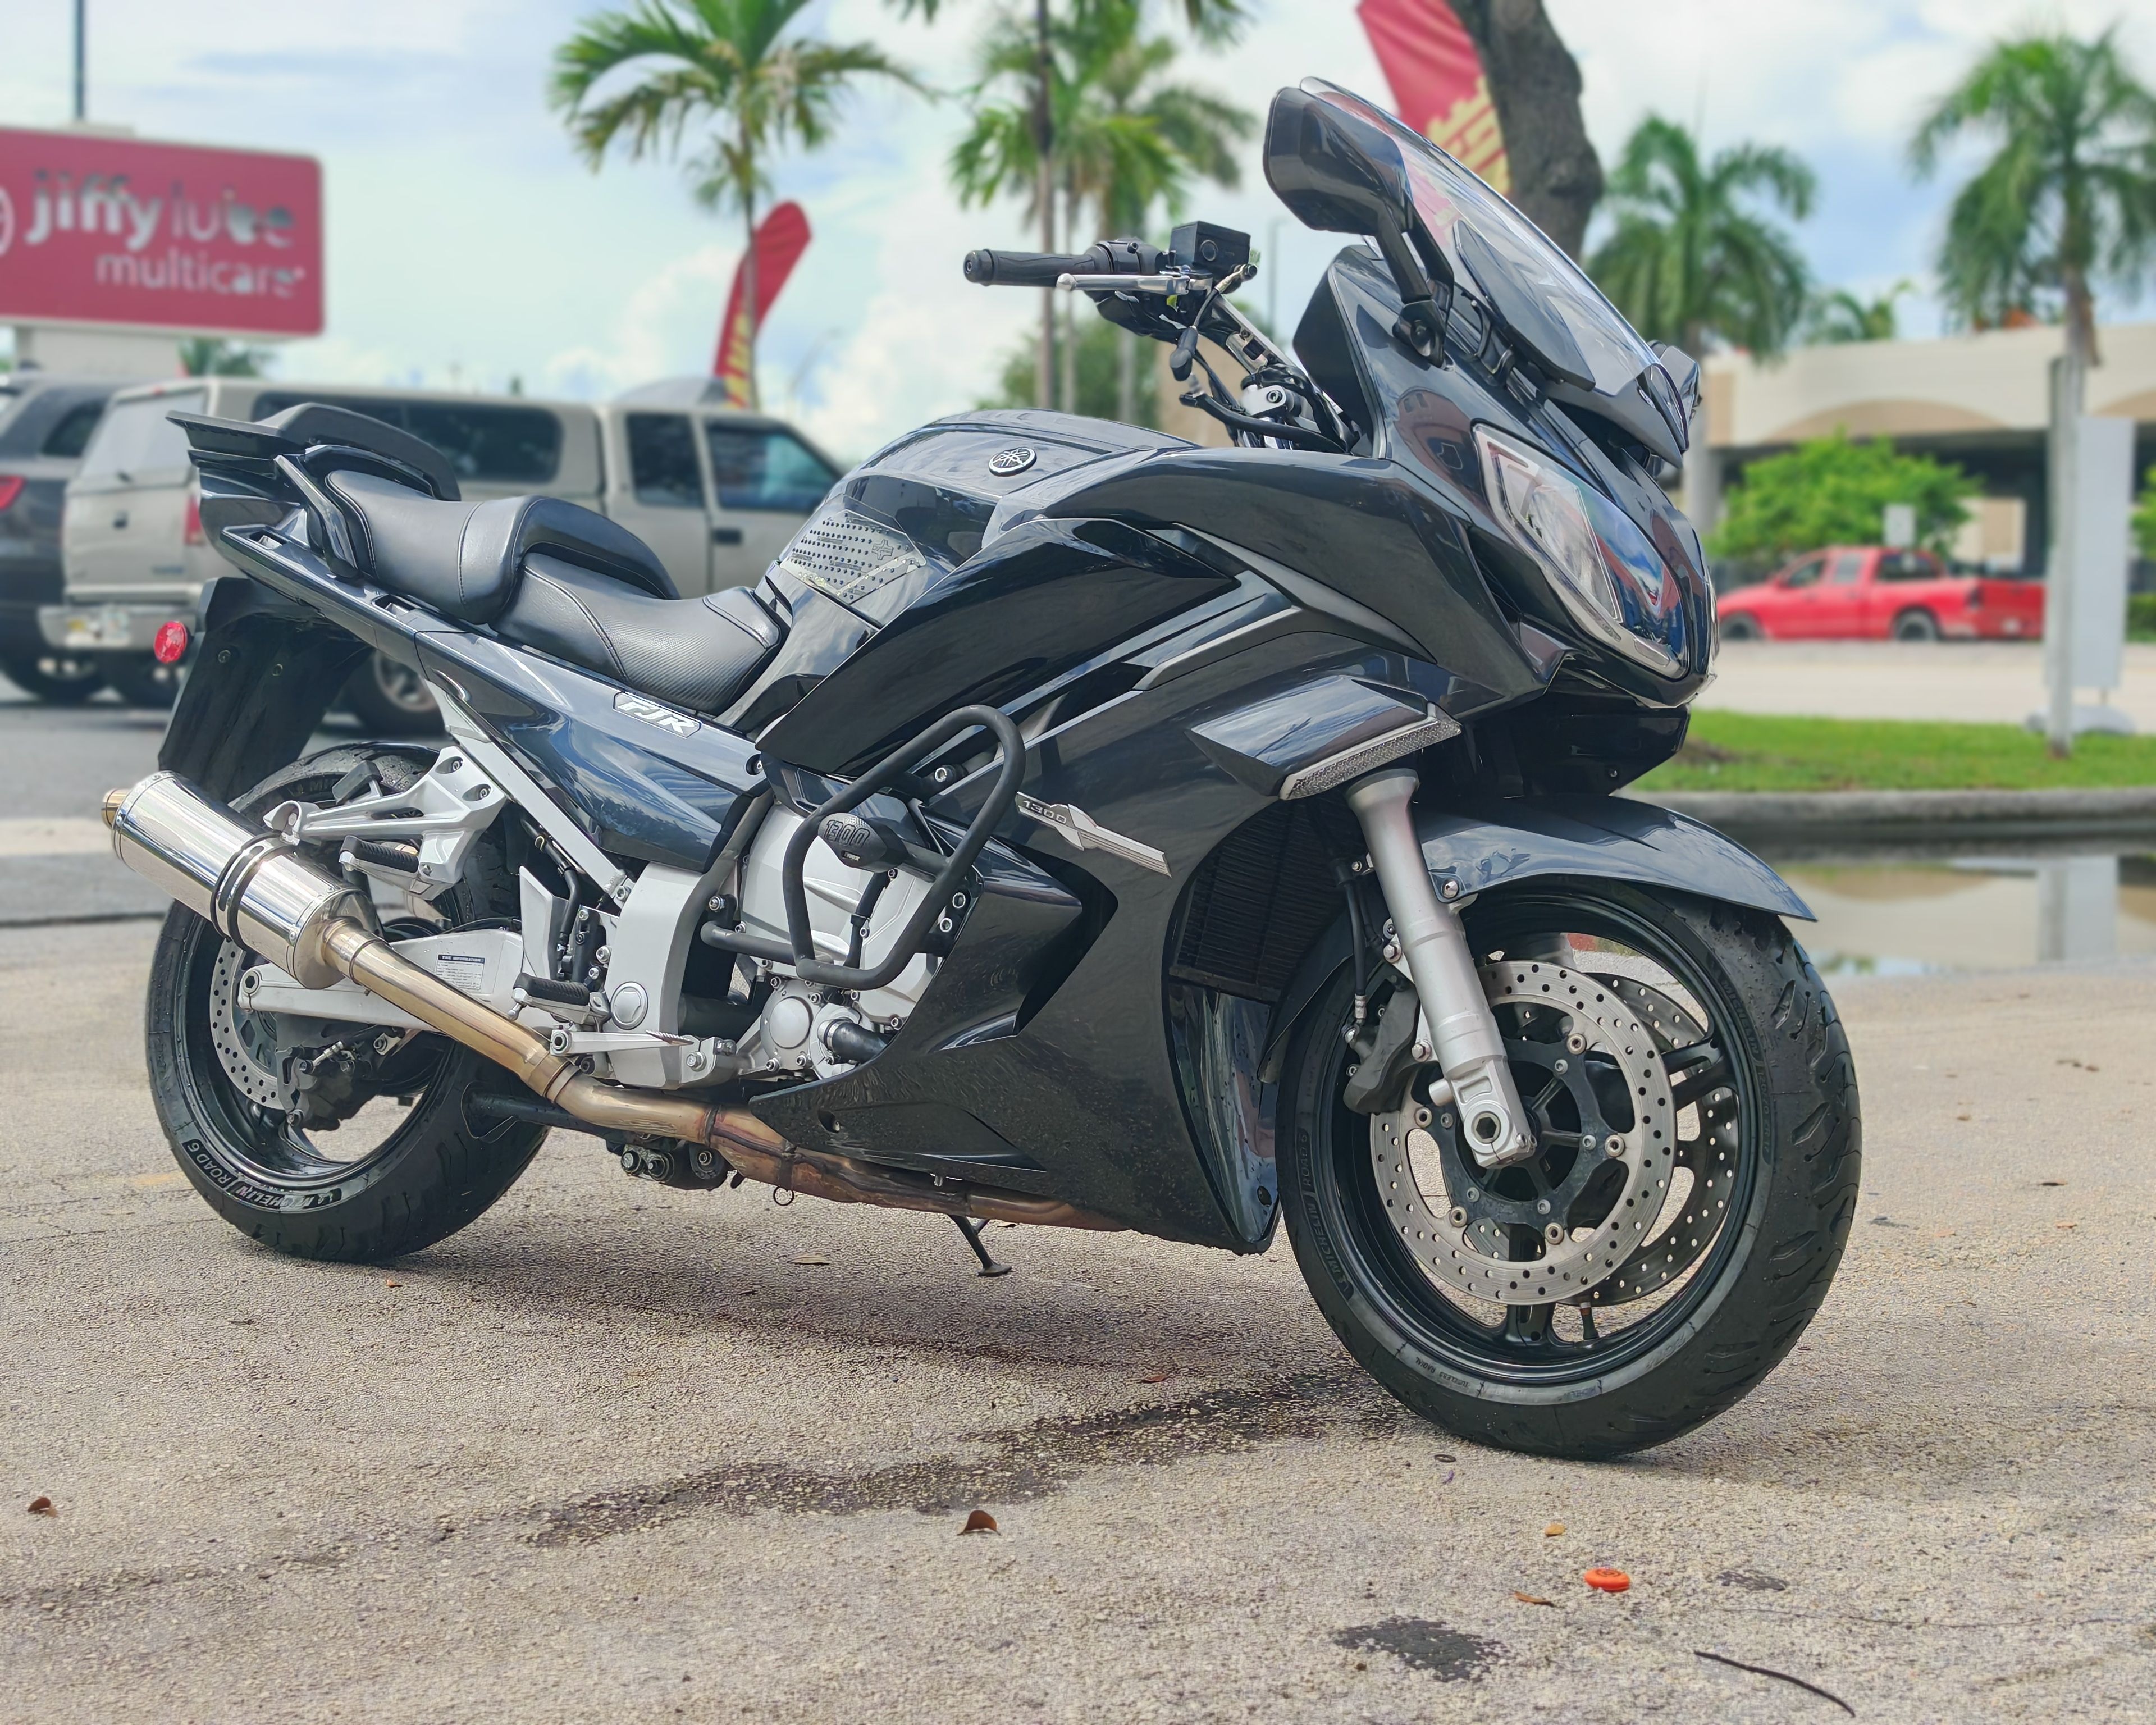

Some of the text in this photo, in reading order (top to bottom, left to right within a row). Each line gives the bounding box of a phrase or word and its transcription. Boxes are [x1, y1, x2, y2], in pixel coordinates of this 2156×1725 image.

[24, 168, 163, 251] jiffy
[96, 246, 296, 298] multicare
[1024, 800, 1066, 824] 1300
[824, 819, 870, 848] 1300
[187, 1143, 200, 1152] 6
[196, 1153, 232, 1184] ROAD
[1299, 1147, 1312, 1186] ROAD
[1307, 1203, 1341, 1274] MICHELIN
[1415, 1357, 1436, 1373] RADIAL
